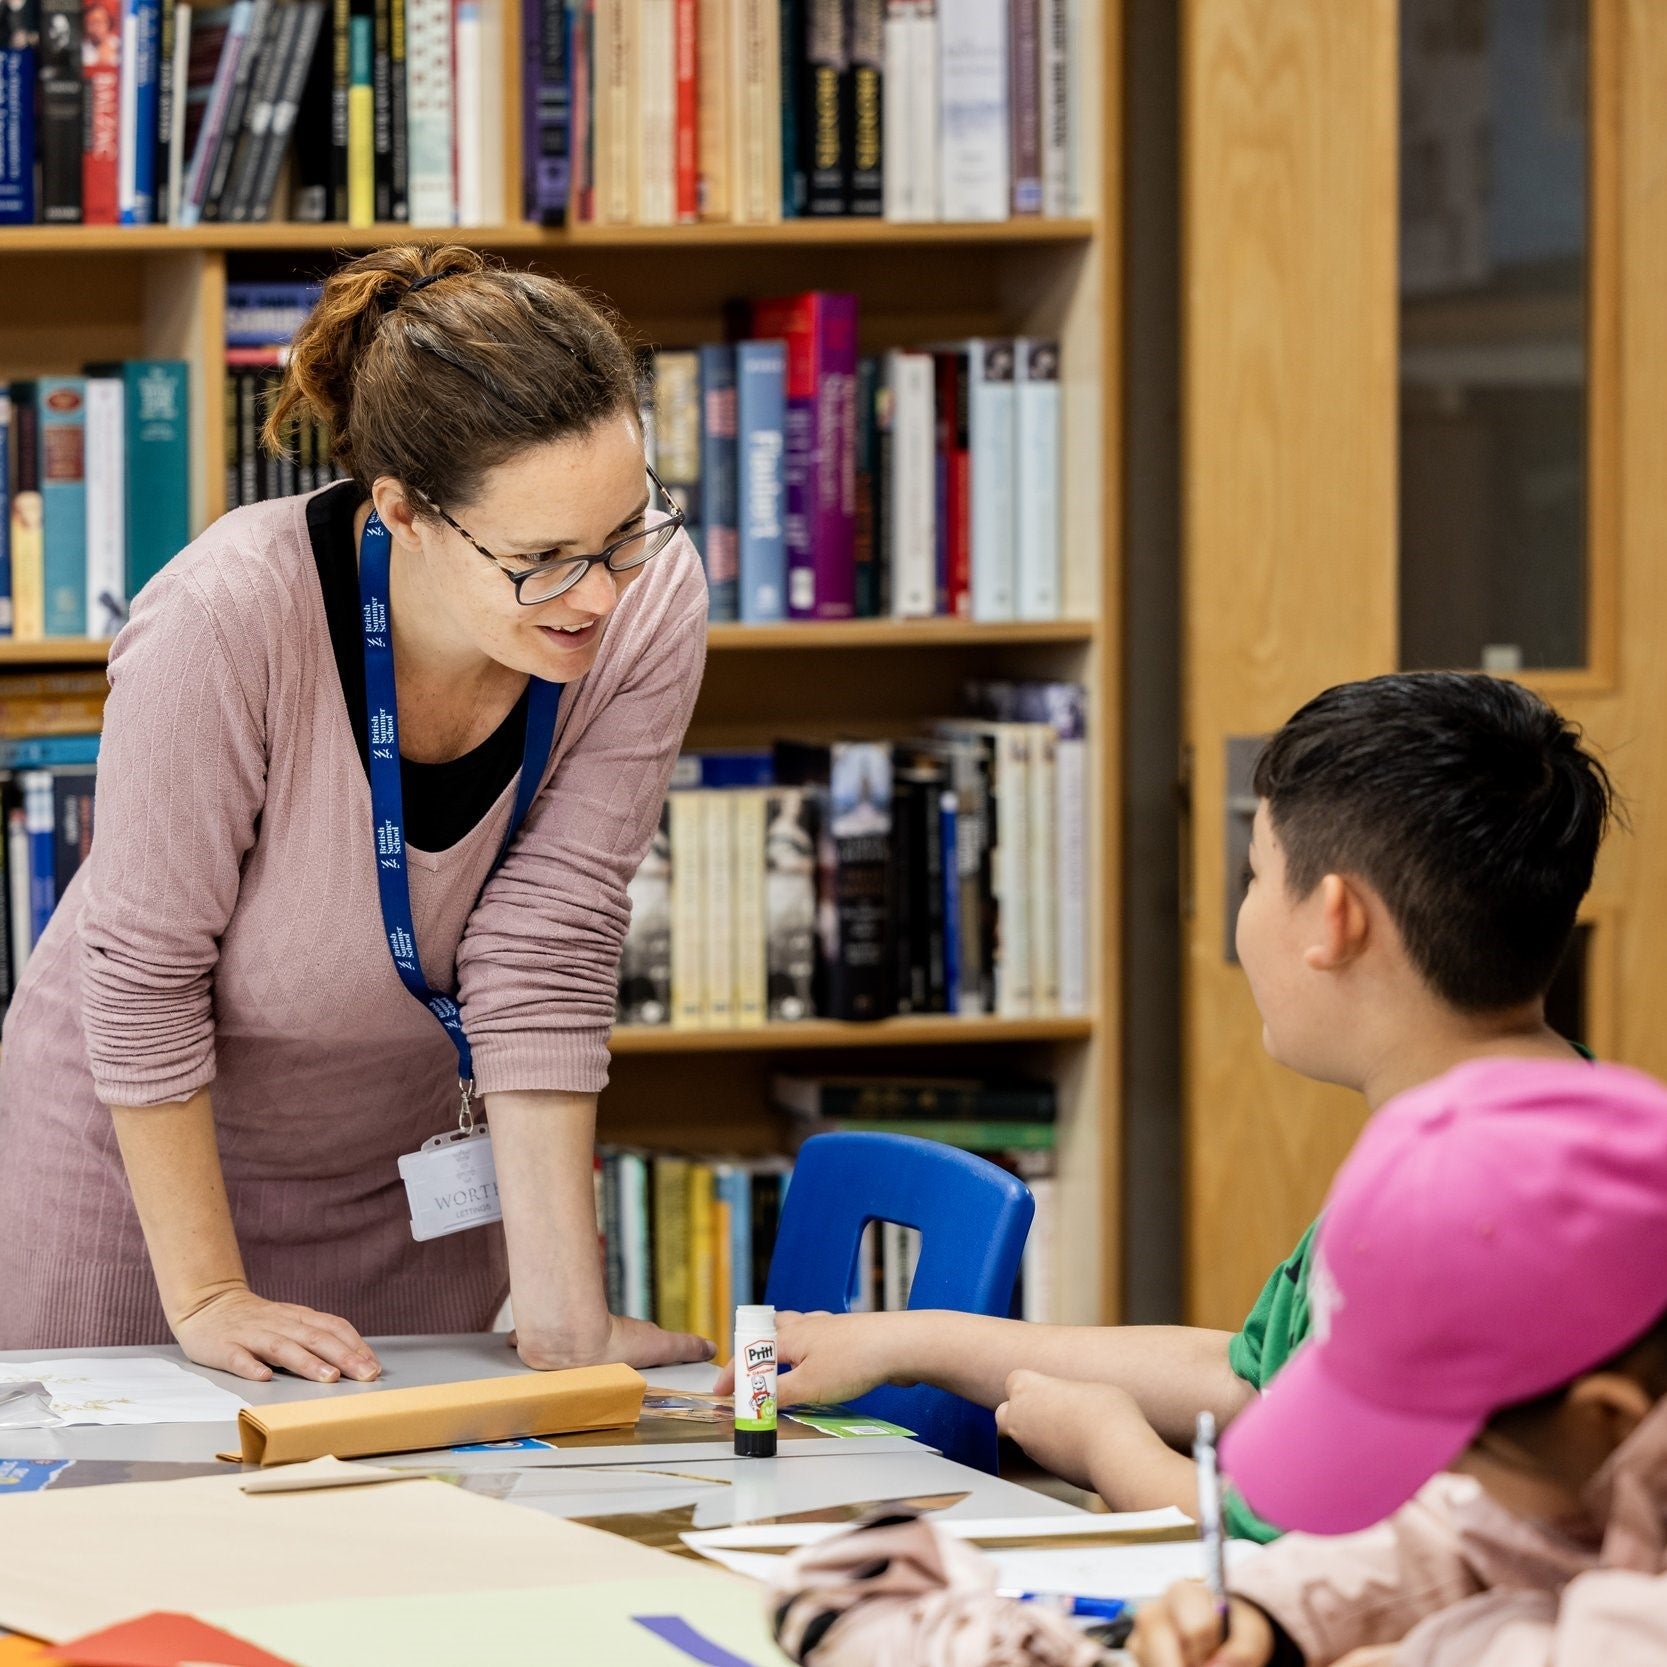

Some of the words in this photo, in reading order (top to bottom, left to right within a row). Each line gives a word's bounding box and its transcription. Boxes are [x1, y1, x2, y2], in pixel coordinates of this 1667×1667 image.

[750, 430, 783, 539] Flaubert
[364, 604, 372, 632] British
[371, 596, 379, 632] Summer
[378, 604, 386, 632] School
[371, 715, 379, 744] British
[379, 708, 387, 744] Summer
[386, 715, 394, 744] School
[378, 827, 386, 854] British
[385, 819, 394, 854] Summer
[391, 826, 401, 854] School
[390, 933, 401, 957] British
[396, 926, 407, 957] Summer
[403, 933, 414, 958] School
[749, 1345, 773, 1361] Pritt
